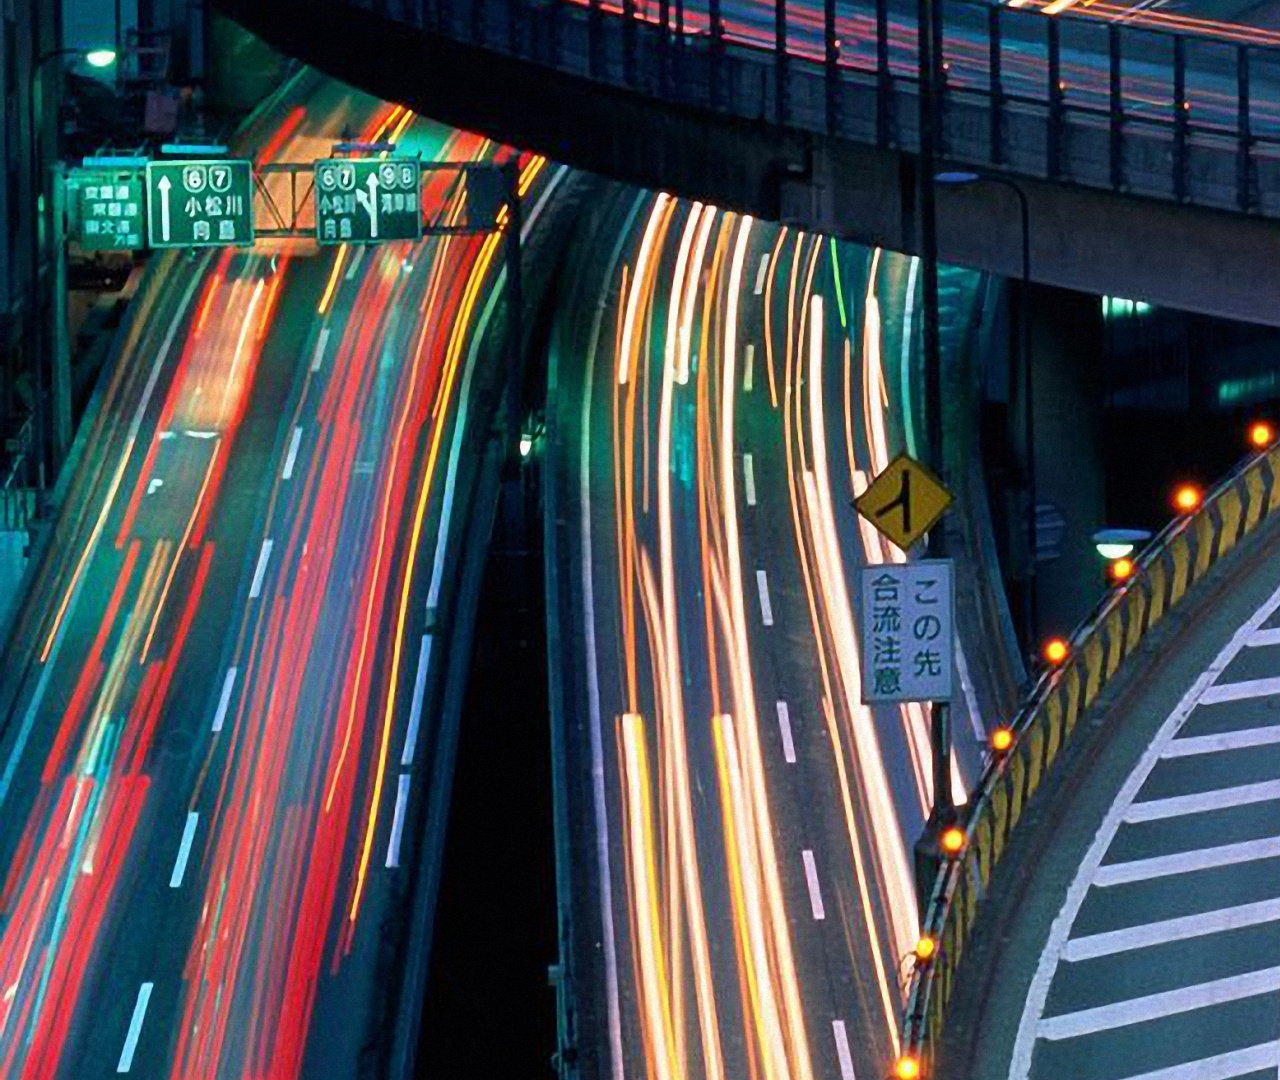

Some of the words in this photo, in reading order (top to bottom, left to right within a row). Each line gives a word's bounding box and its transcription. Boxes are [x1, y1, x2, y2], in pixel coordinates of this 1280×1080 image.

[185, 195, 243, 218] 小松川
[871, 573, 902, 696] 合流注意
[913, 578, 942, 677] この先
